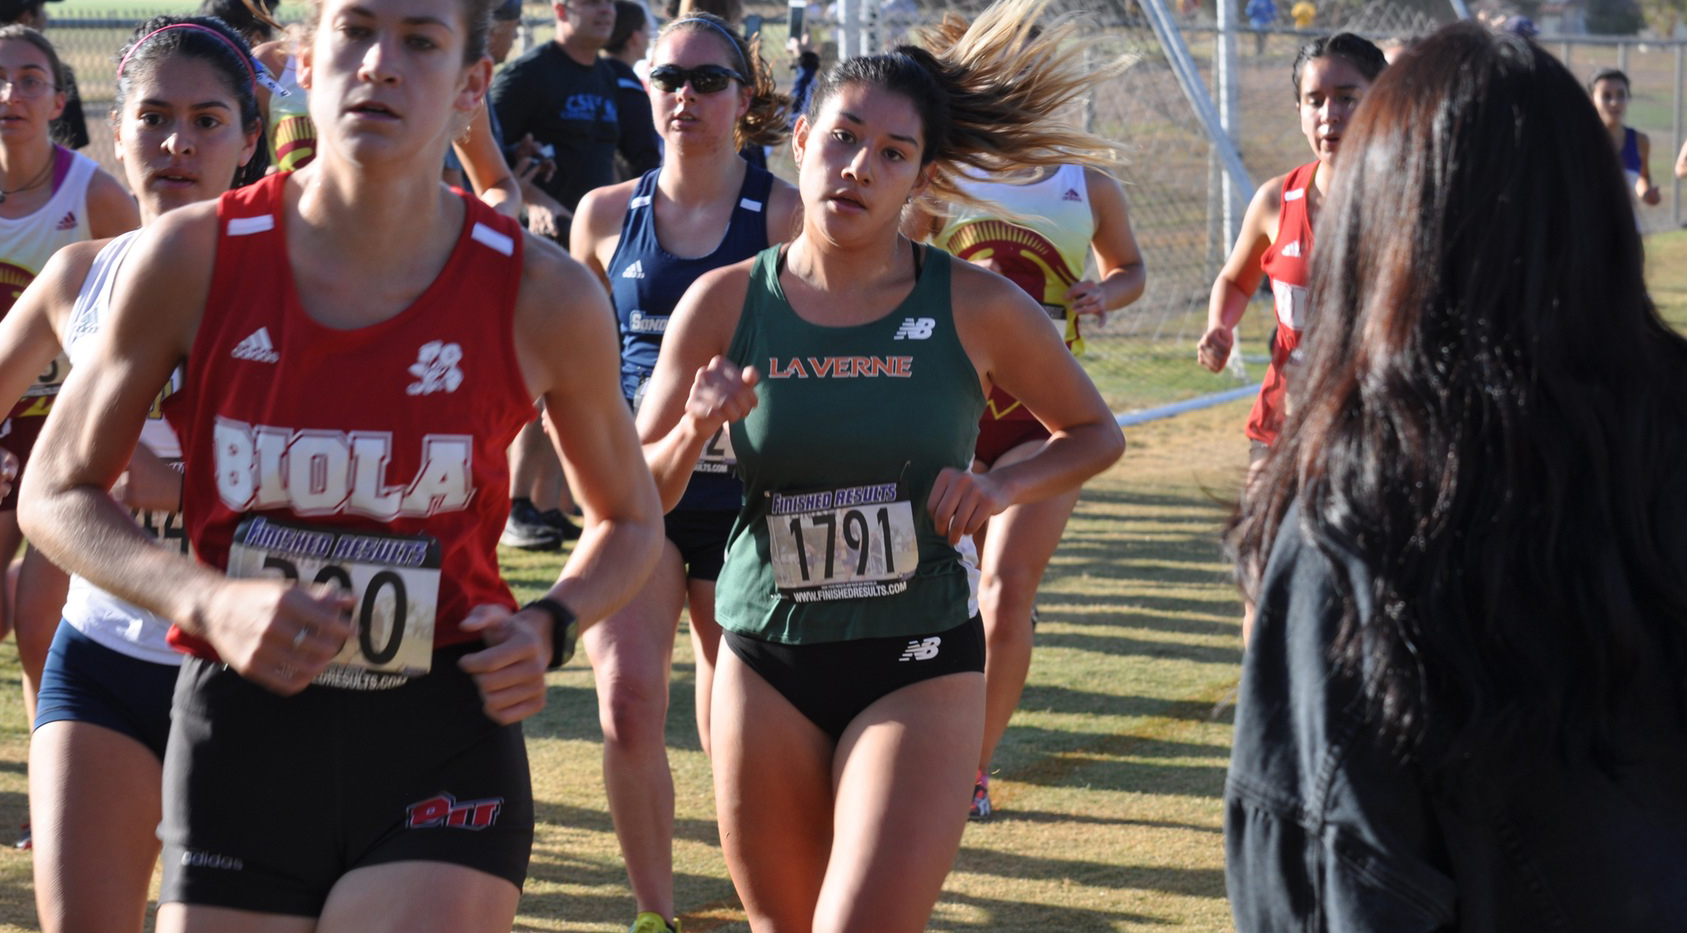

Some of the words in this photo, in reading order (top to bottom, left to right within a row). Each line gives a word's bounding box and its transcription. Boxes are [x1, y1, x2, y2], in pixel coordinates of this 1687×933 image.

[807, 355, 914, 378] VERNE
[213, 415, 477, 524] BIOLA
[771, 491, 832, 515] FINISHED
[834, 482, 897, 508] RESULTS
[331, 534, 430, 568] RESULTS
[789, 506, 895, 582] 1791
[793, 580, 907, 603] WWW.FINISHEDRESULTS.COM
[181, 850, 244, 871] adidas
